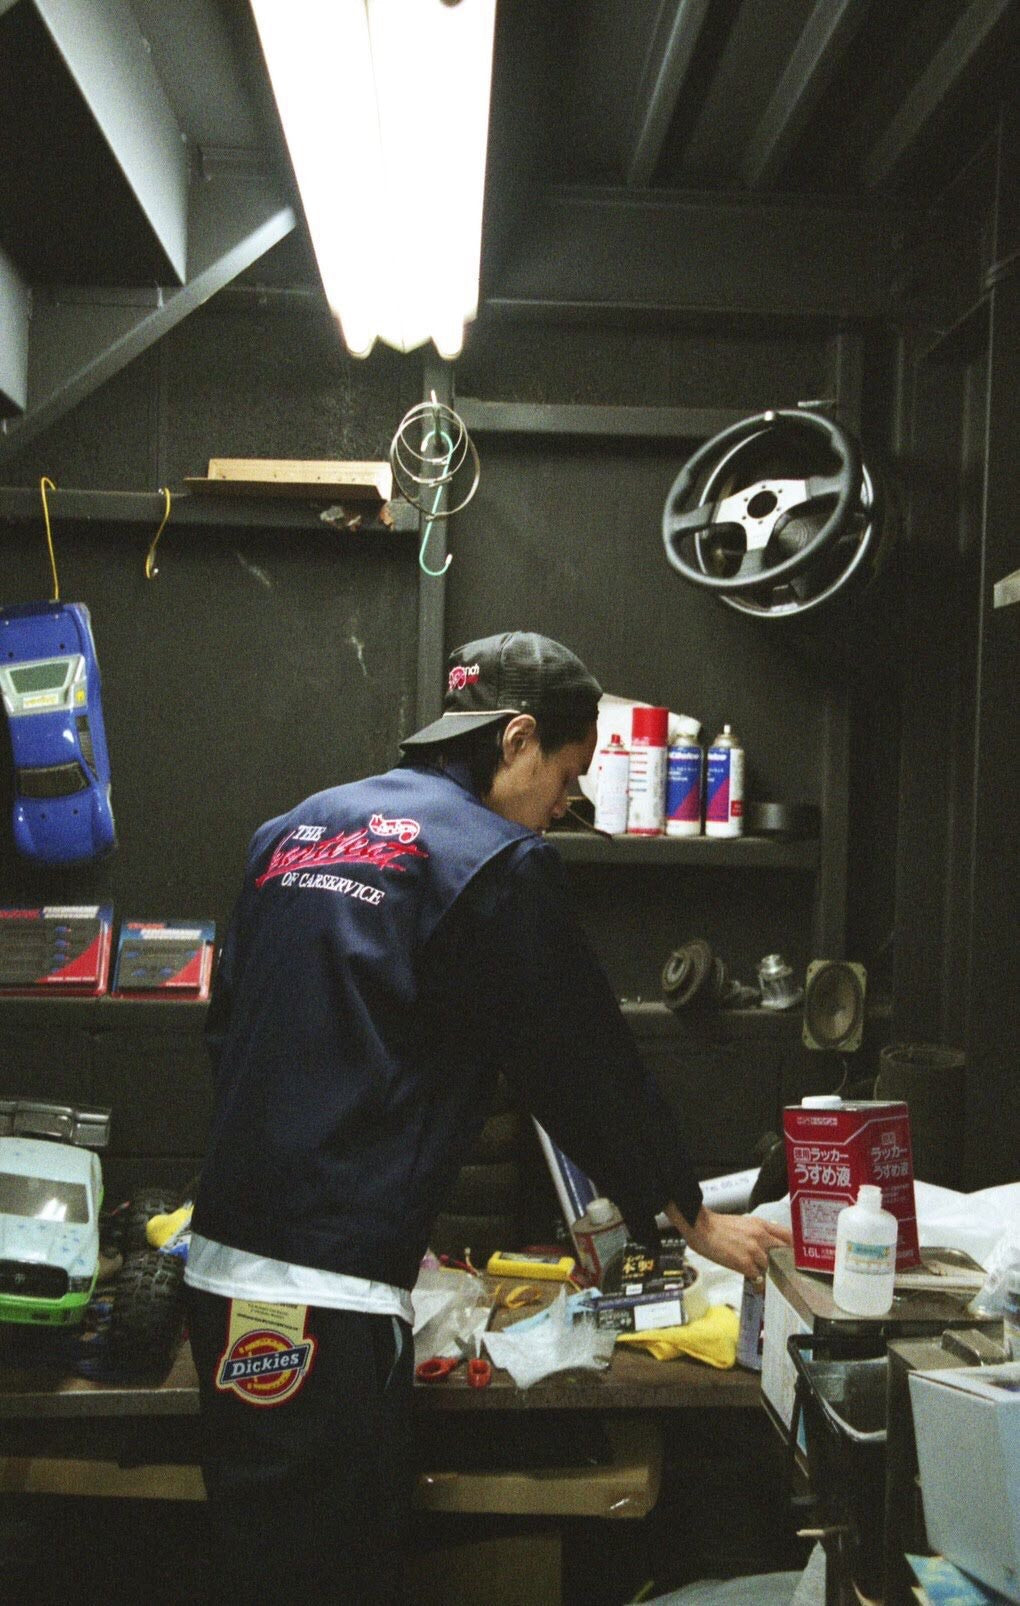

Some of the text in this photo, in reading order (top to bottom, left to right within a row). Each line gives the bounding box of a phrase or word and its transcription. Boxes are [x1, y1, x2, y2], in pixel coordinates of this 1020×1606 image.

[292, 825, 327, 842] THE
[281, 871, 387, 906] OF CARSERVICE
[794, 1163, 851, 1187] うすめ液
[231, 1352, 300, 1377] Dickies
